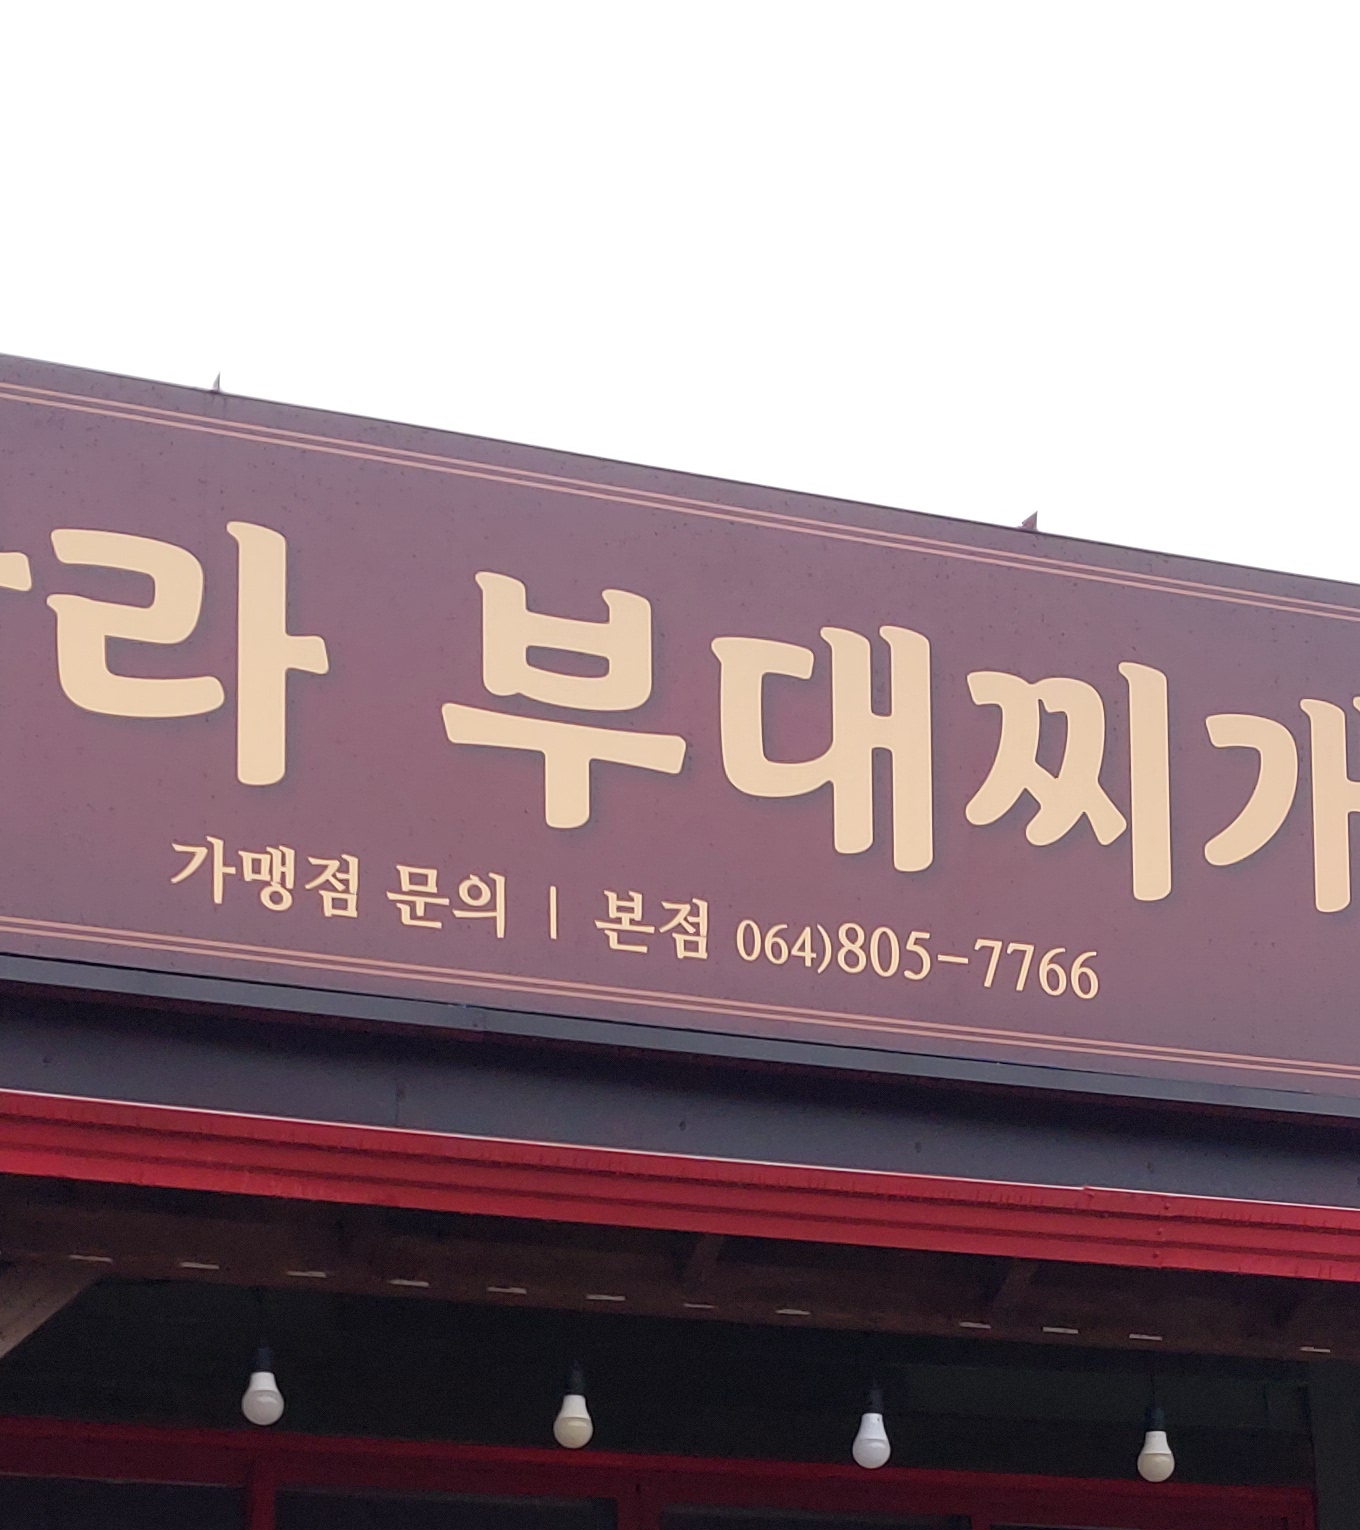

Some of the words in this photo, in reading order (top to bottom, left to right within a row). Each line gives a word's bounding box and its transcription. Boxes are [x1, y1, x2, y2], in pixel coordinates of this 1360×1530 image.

[170, 836, 361, 919] 가맹점
[385, 865, 507, 939] 문의
[593, 890, 710, 961] 본점
[734, 917, 1100, 1001] 064)805-7766
